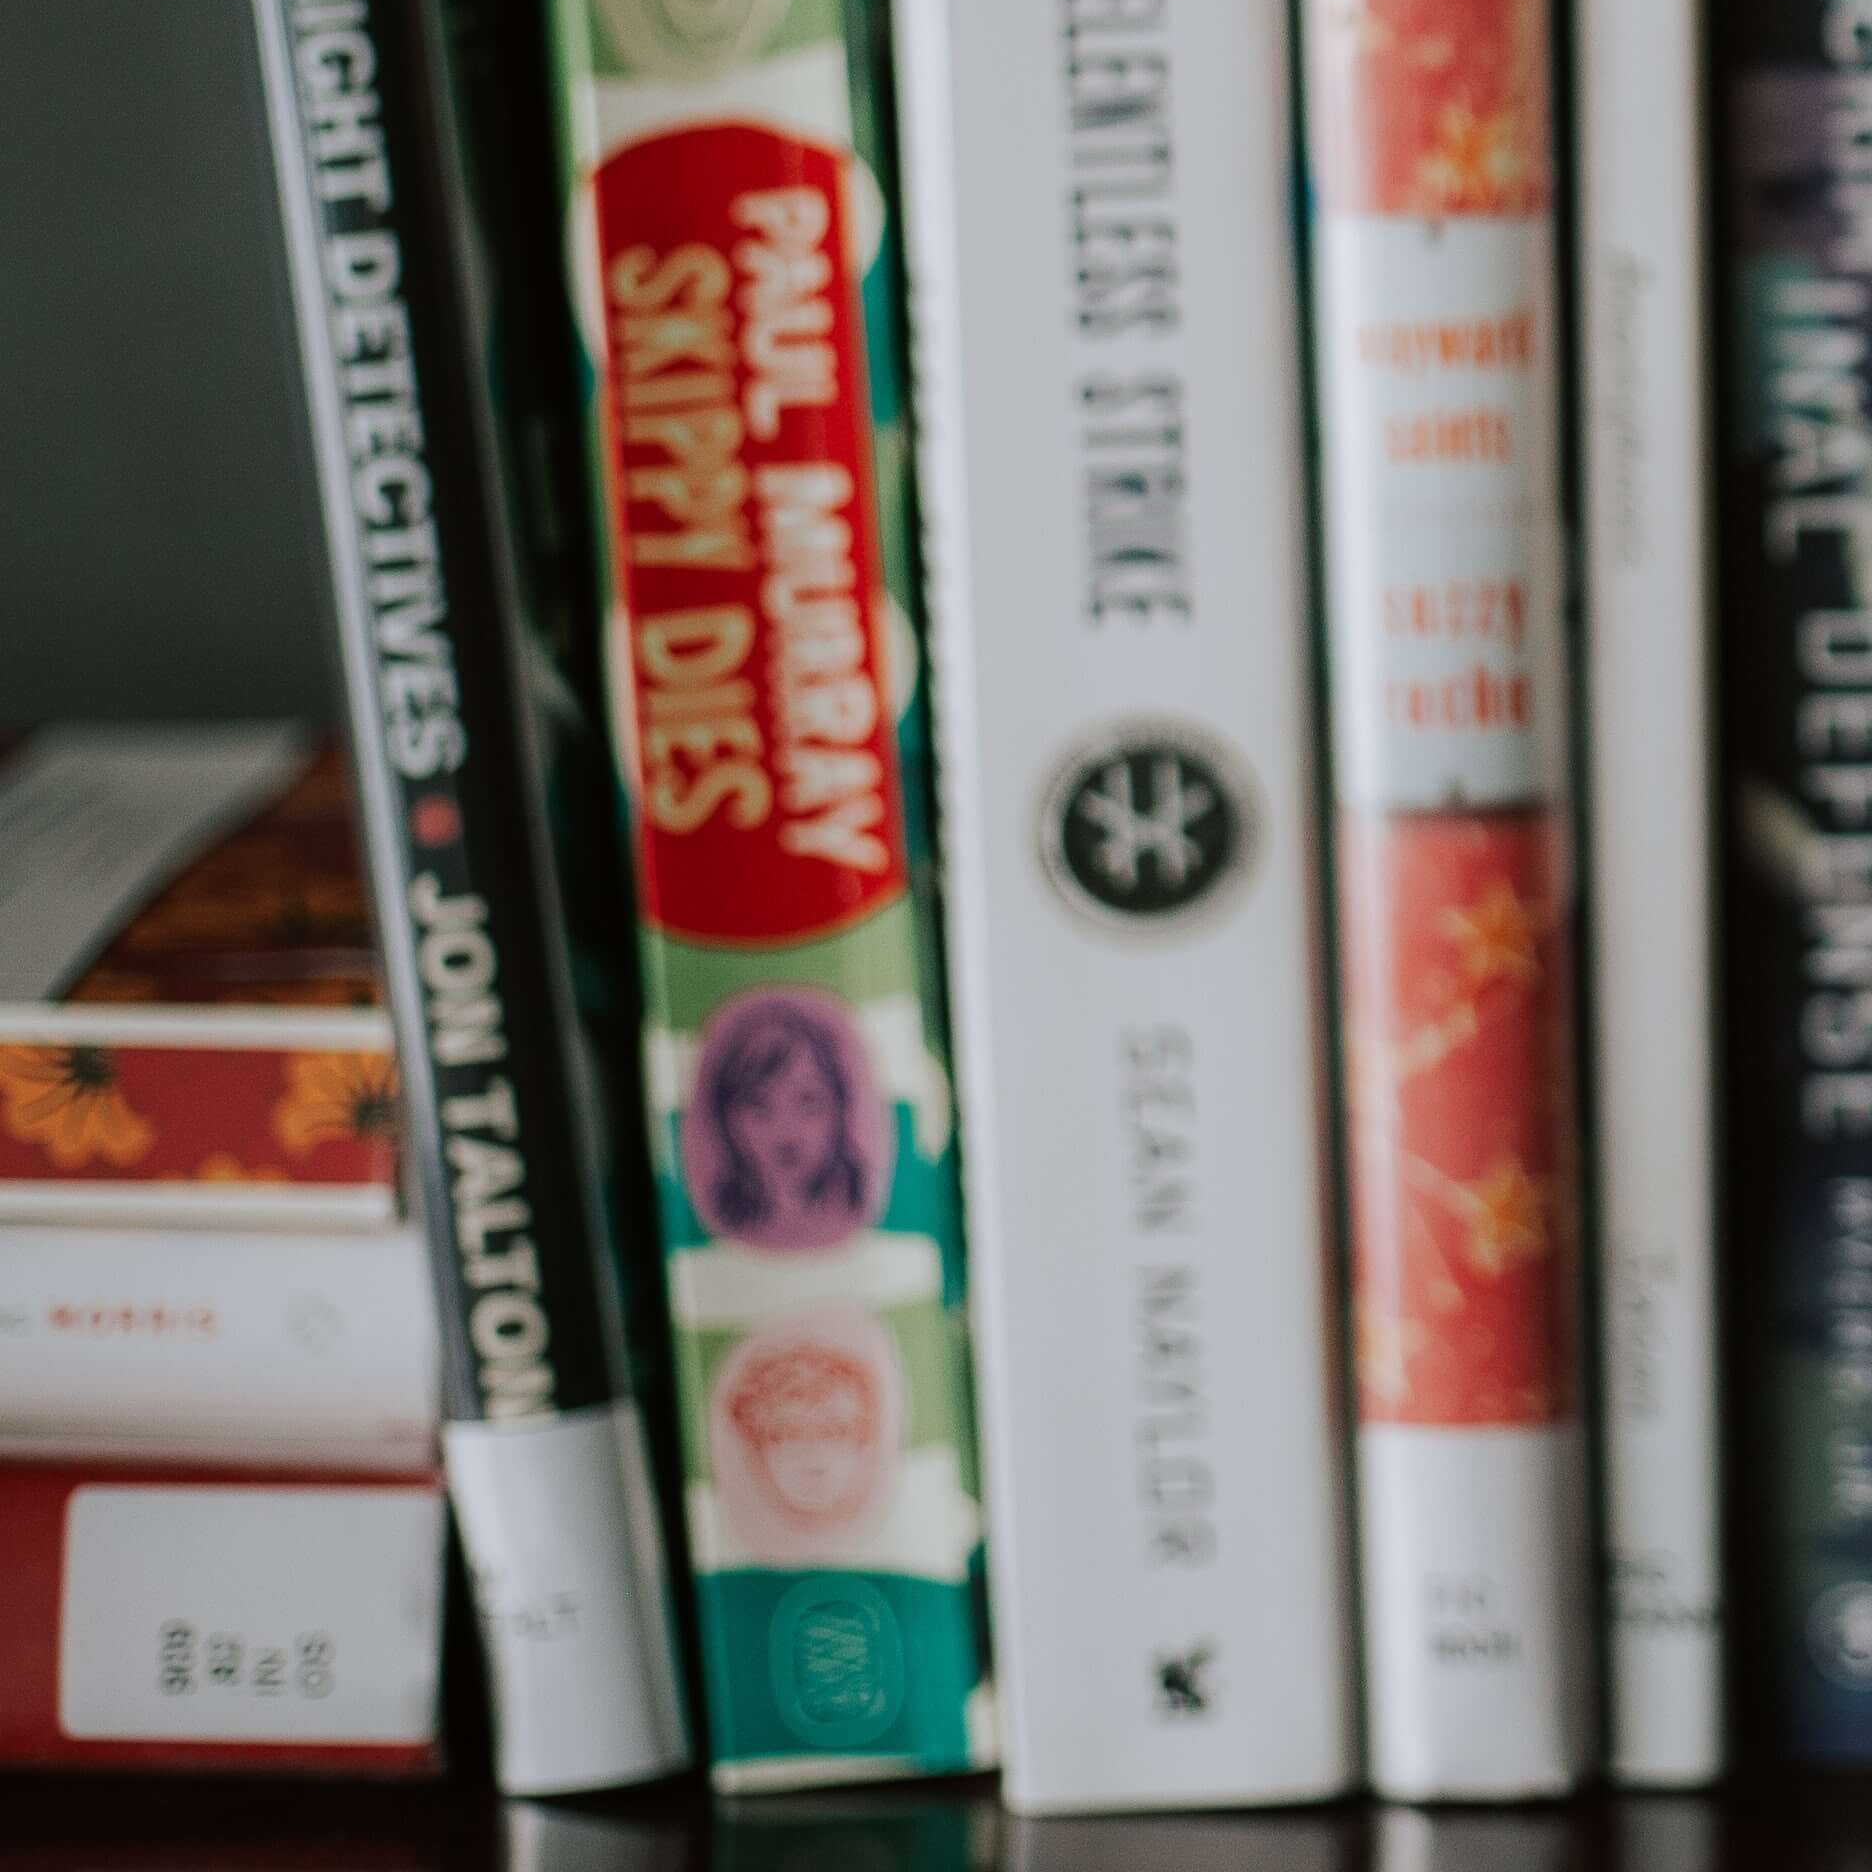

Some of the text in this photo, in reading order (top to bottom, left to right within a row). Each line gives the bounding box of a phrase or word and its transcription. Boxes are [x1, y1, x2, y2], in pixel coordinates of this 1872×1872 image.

[325, 228, 466, 776] DETECTIVES
[609, 243, 772, 834] SKIPPY DIES
[731, 184, 890, 876] PAUL MURRAY
[1080, 368, 1194, 631] STRIKE
[408, 871, 505, 1067] JON
[1118, 1024, 1219, 1571] SEAN NAYLOR
